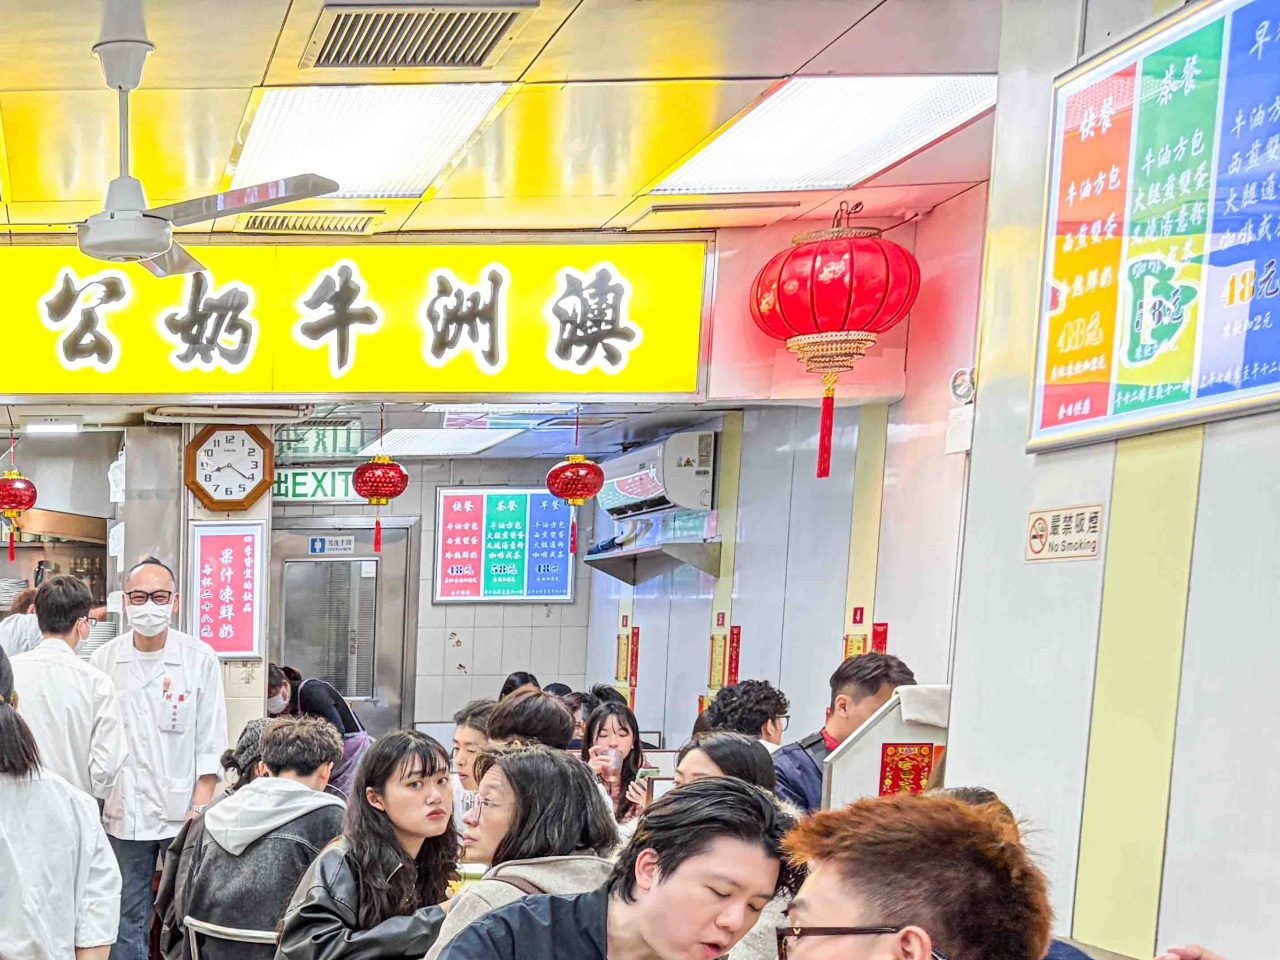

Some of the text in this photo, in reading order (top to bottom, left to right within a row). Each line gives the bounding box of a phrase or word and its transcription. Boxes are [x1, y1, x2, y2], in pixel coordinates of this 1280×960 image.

[1247, 19, 1280, 61] 早
[1157, 53, 1203, 107] 茶餐
[1079, 96, 1117, 143] 快餐
[1141, 127, 1206, 179] 牛油方包
[1064, 164, 1122, 209] 牛油方包
[1219, 258, 1280, 309] 48元
[1056, 310, 1105, 355] 48元
[213, 439, 220, 448] 11
[225, 435, 235, 444] 12
[241, 439, 245, 447] 1
[204, 449, 214, 457] 10
[247, 448, 256, 457] 2
[251, 460, 258, 469] 3
[204, 474, 212, 483] 8
[248, 473, 255, 482] 4
[212, 484, 220, 493] 7
[238, 484, 246, 492] 5
[291, 471, 353, 498] EXIT
[225, 487, 233, 496] 6
[1048, 539, 1098, 553] No Smoking
